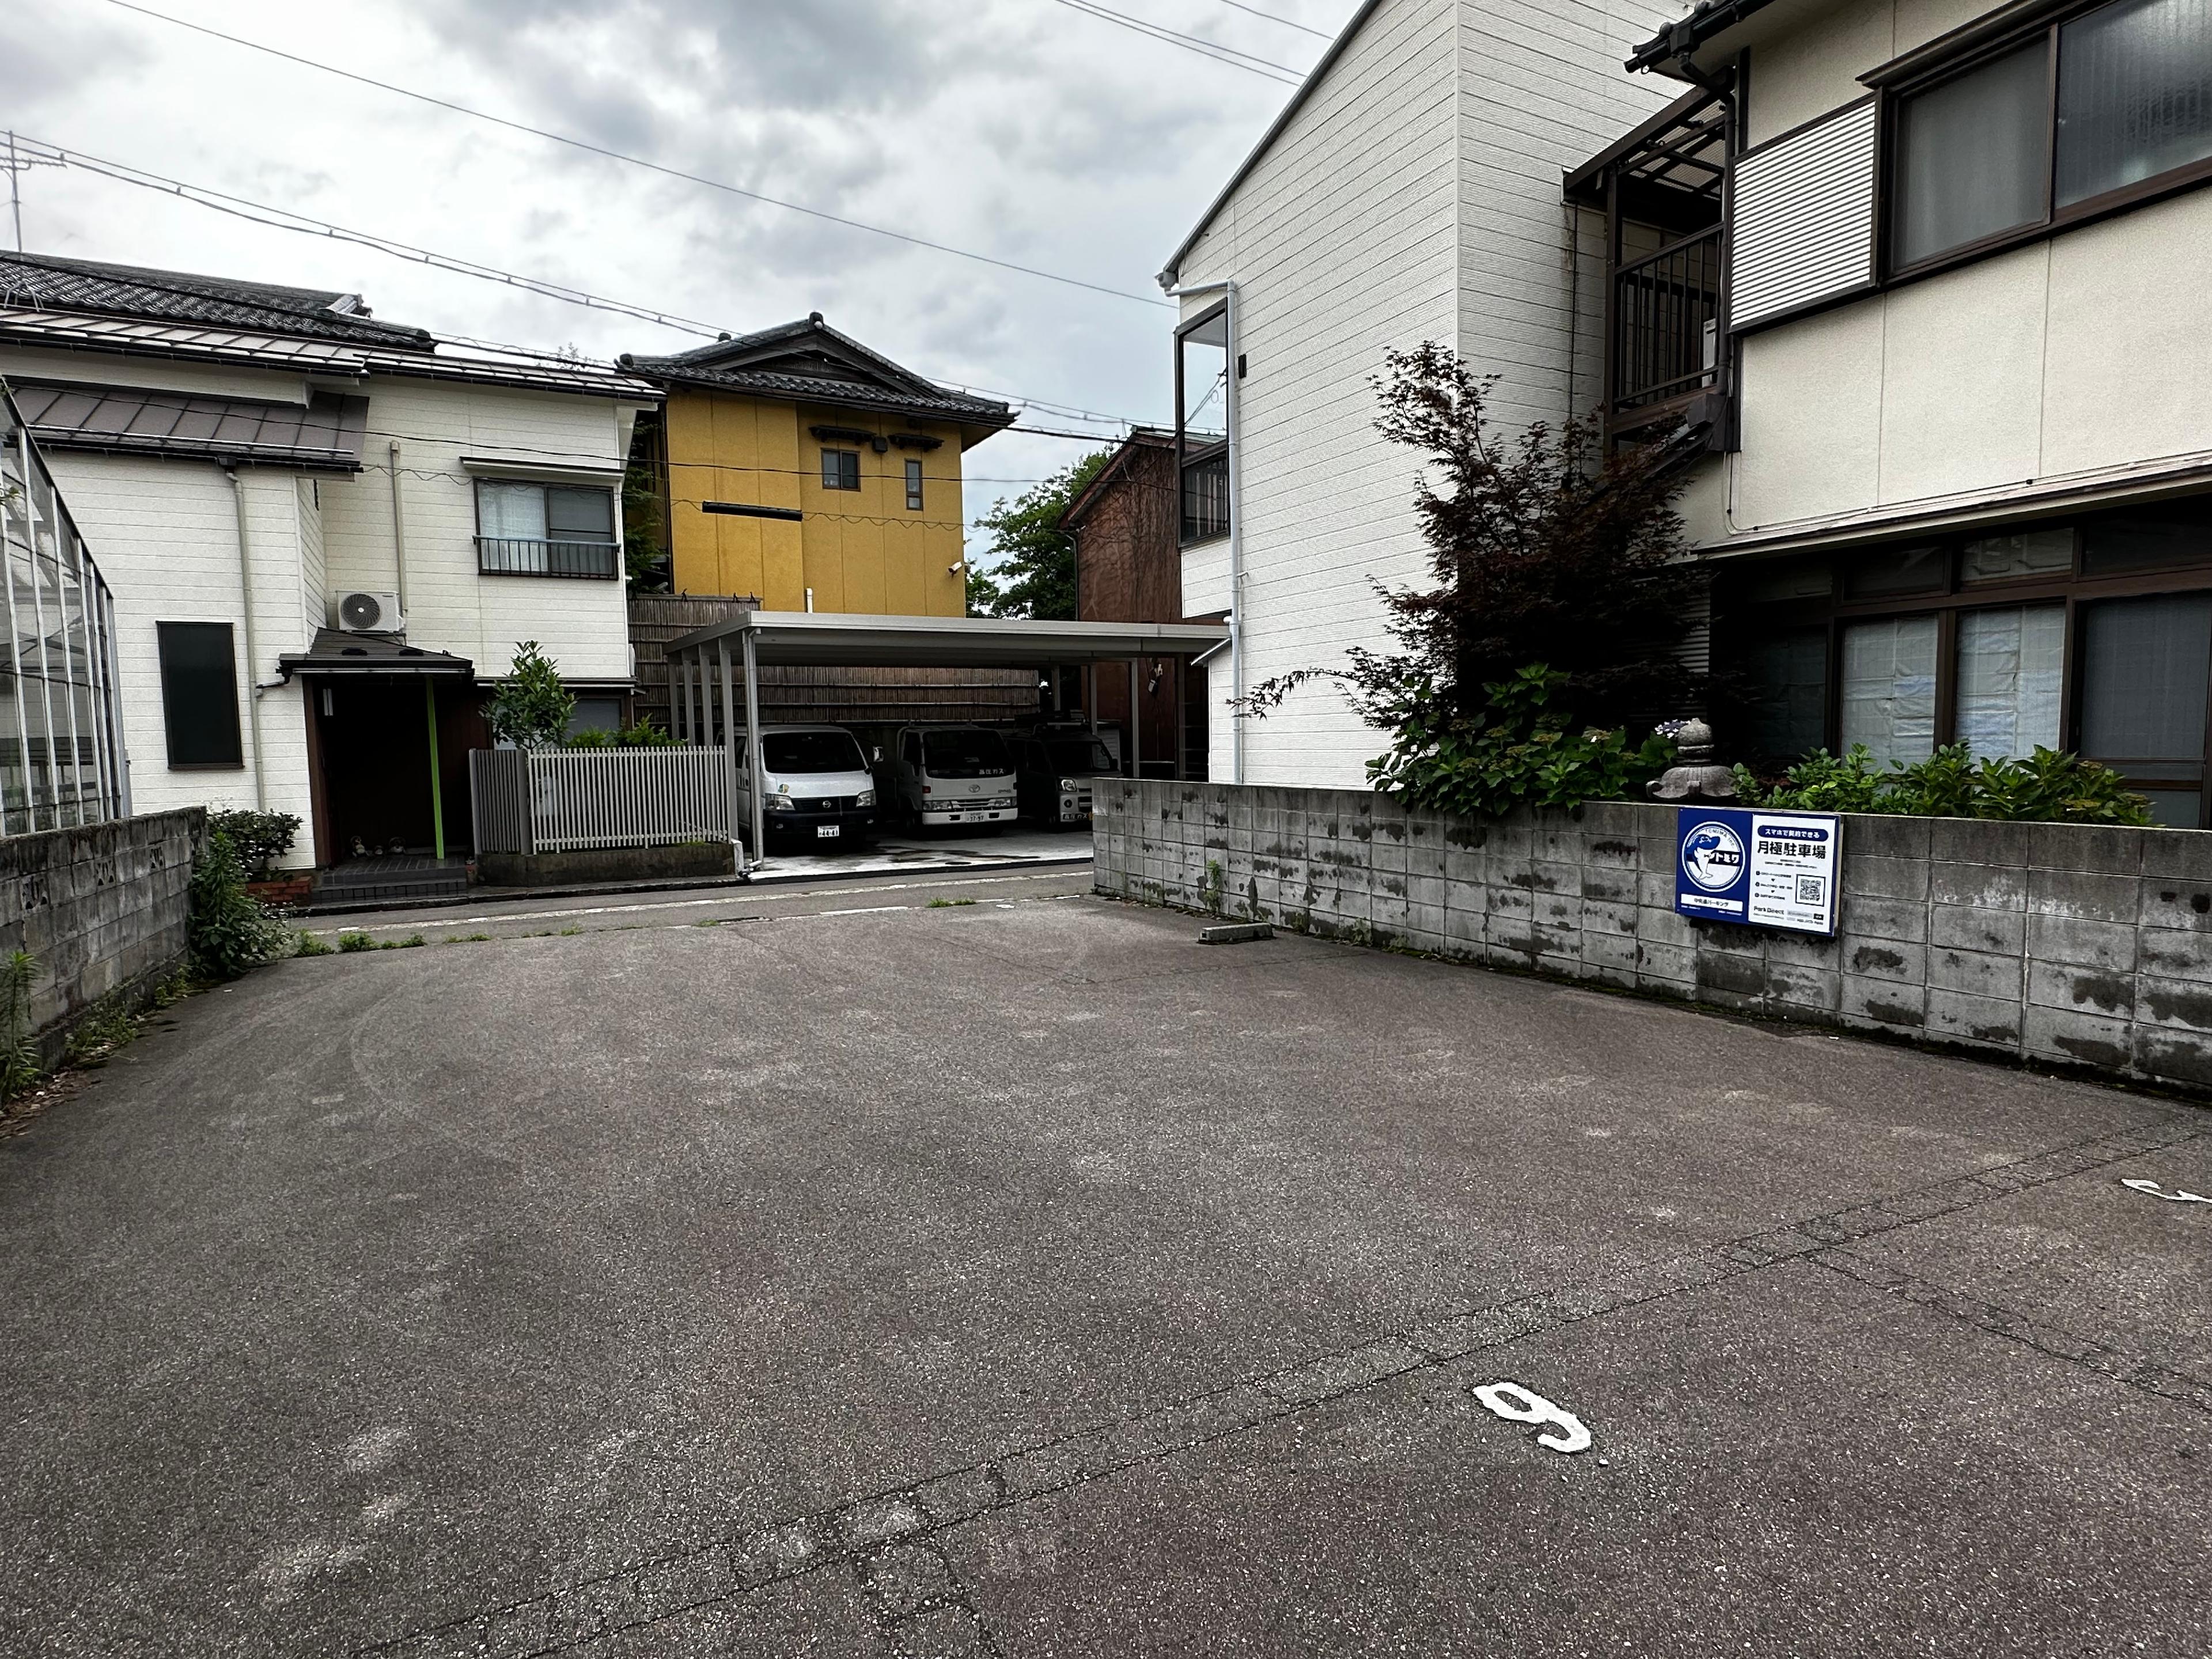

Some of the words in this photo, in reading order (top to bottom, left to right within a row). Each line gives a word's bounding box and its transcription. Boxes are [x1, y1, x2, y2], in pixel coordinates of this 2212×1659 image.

[1764, 828, 1820, 838] スマホで契約できる
[1758, 840, 1827, 859] 月極駐車場
[1472, 1382, 1592, 1452] 9
